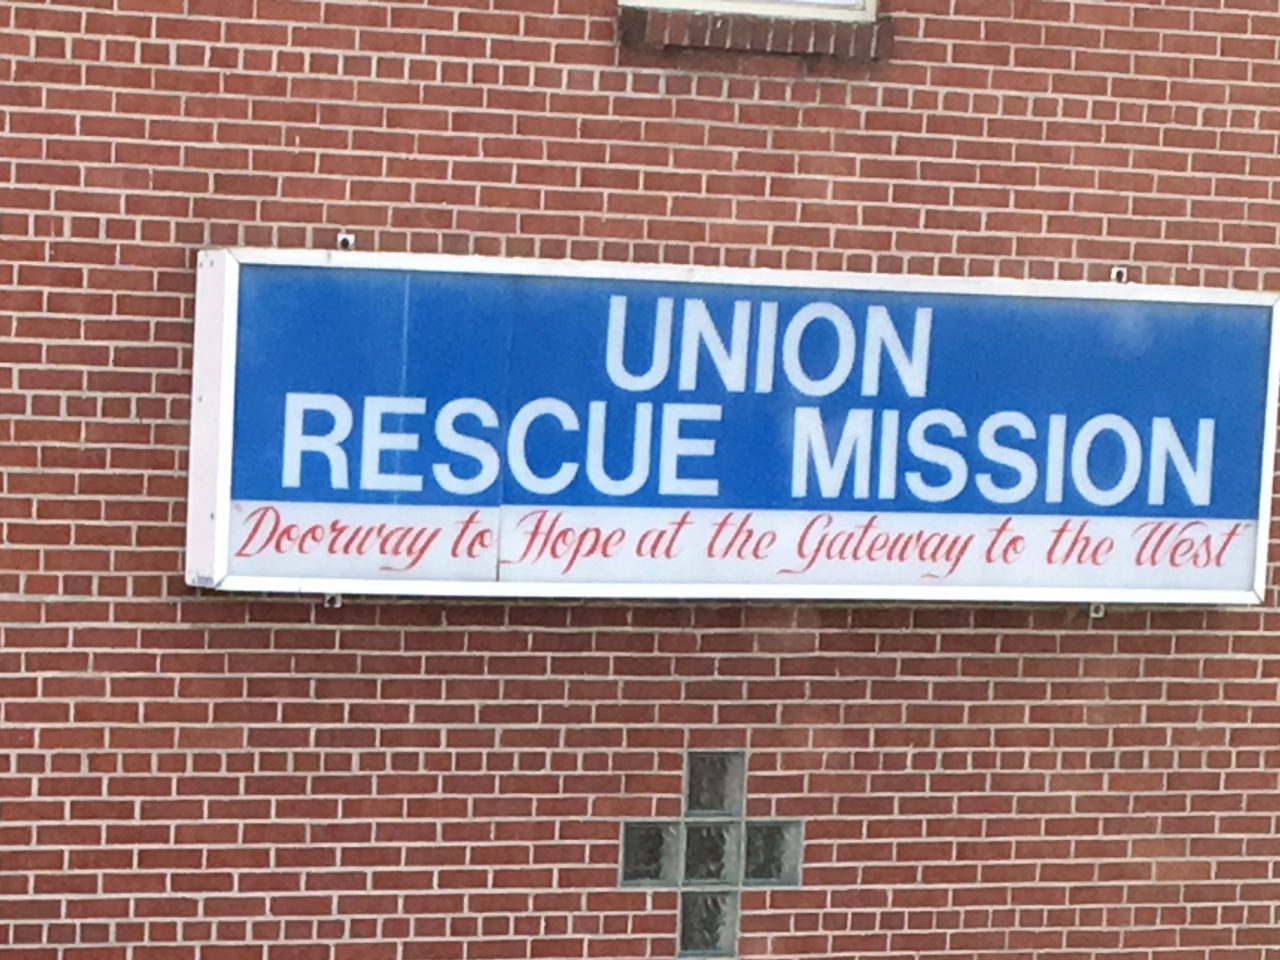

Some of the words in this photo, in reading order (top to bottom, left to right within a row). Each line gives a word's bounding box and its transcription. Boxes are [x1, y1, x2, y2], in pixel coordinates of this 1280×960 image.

[606, 294, 933, 398] UNION
[281, 391, 722, 496] RESCUE
[790, 405, 1215, 506] MISSION
[451, 509, 498, 558] to
[499, 509, 626, 575] Hope
[635, 510, 695, 560] at
[706, 511, 777, 560] the
[776, 512, 975, 579] Gateway
[984, 516, 1026, 565] to
[1045, 517, 1115, 567] the
